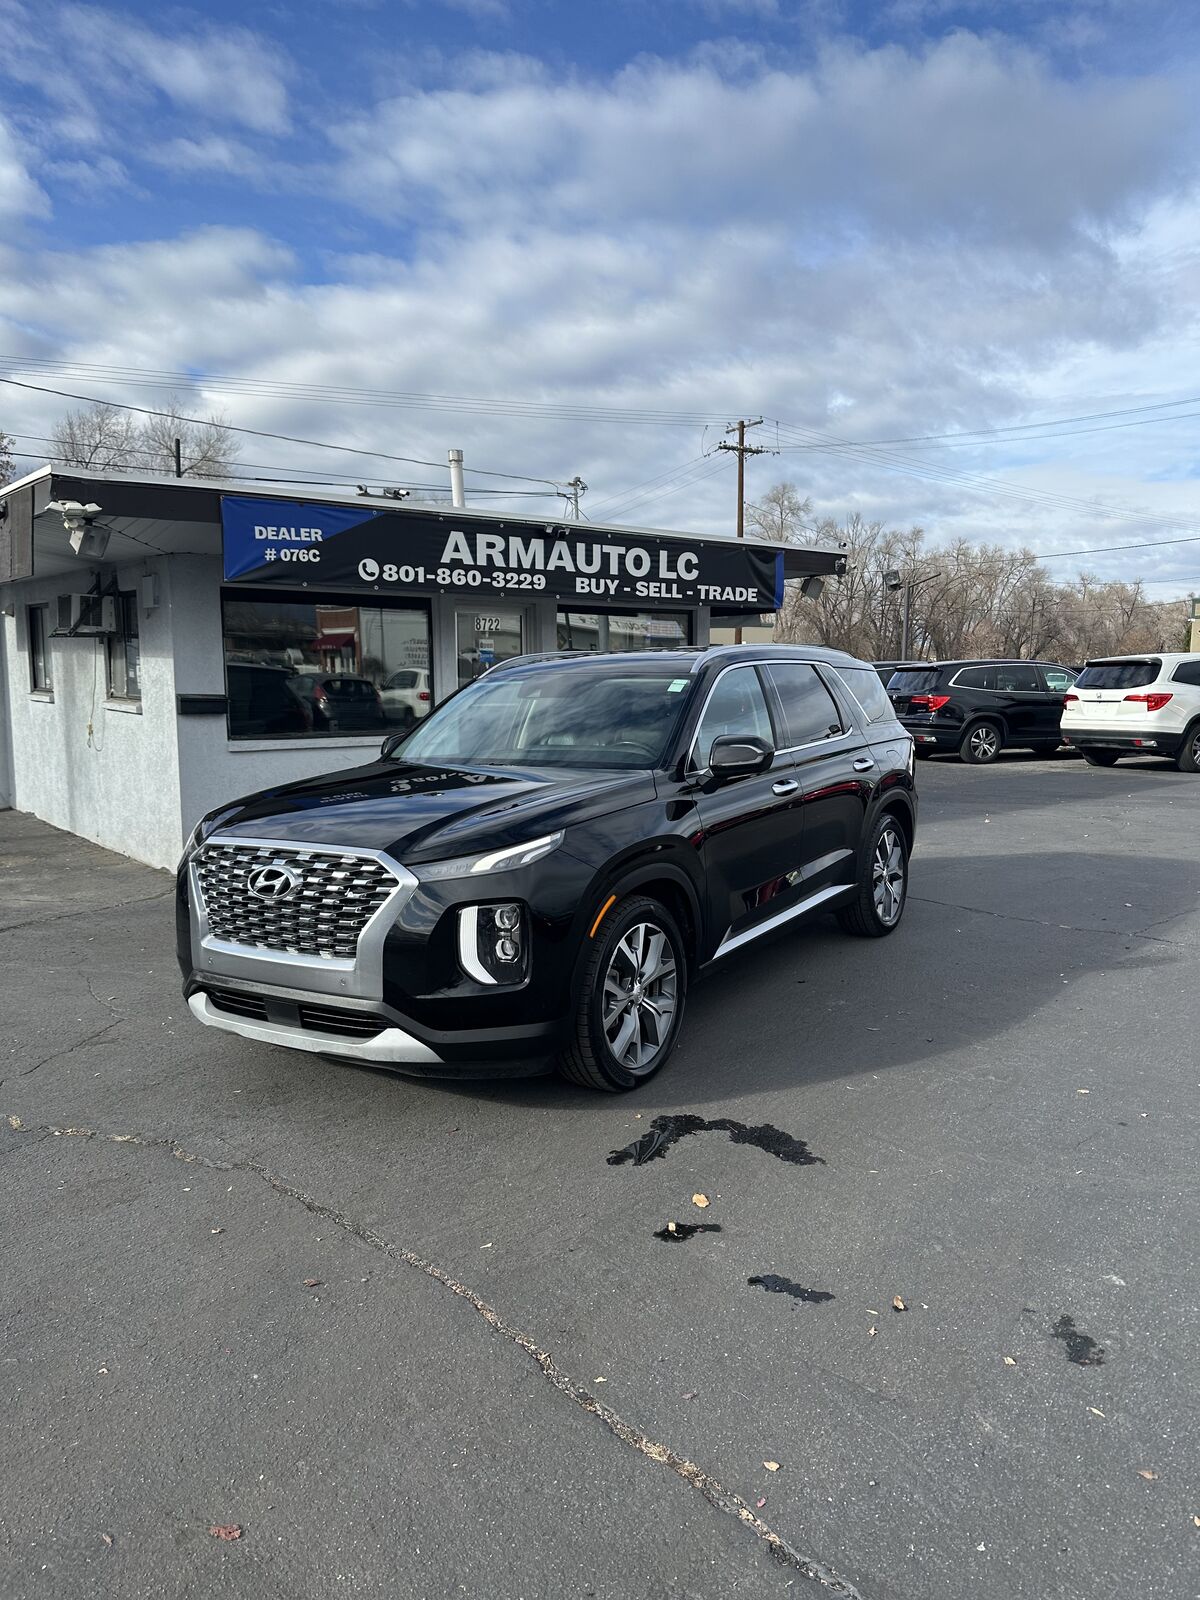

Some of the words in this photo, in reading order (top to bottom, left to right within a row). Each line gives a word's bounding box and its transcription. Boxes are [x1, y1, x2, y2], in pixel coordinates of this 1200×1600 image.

[254, 525, 323, 542] DEALER
[439, 530, 651, 578] ARMAUTO
[658, 549, 700, 581] LC
[382, 563, 547, 590] 801-860-3229
[575, 576, 620, 595] BUY
[635, 580, 683, 599] SELL
[696, 584, 758, 602] TRADE
[475, 617, 500, 631] 8722
